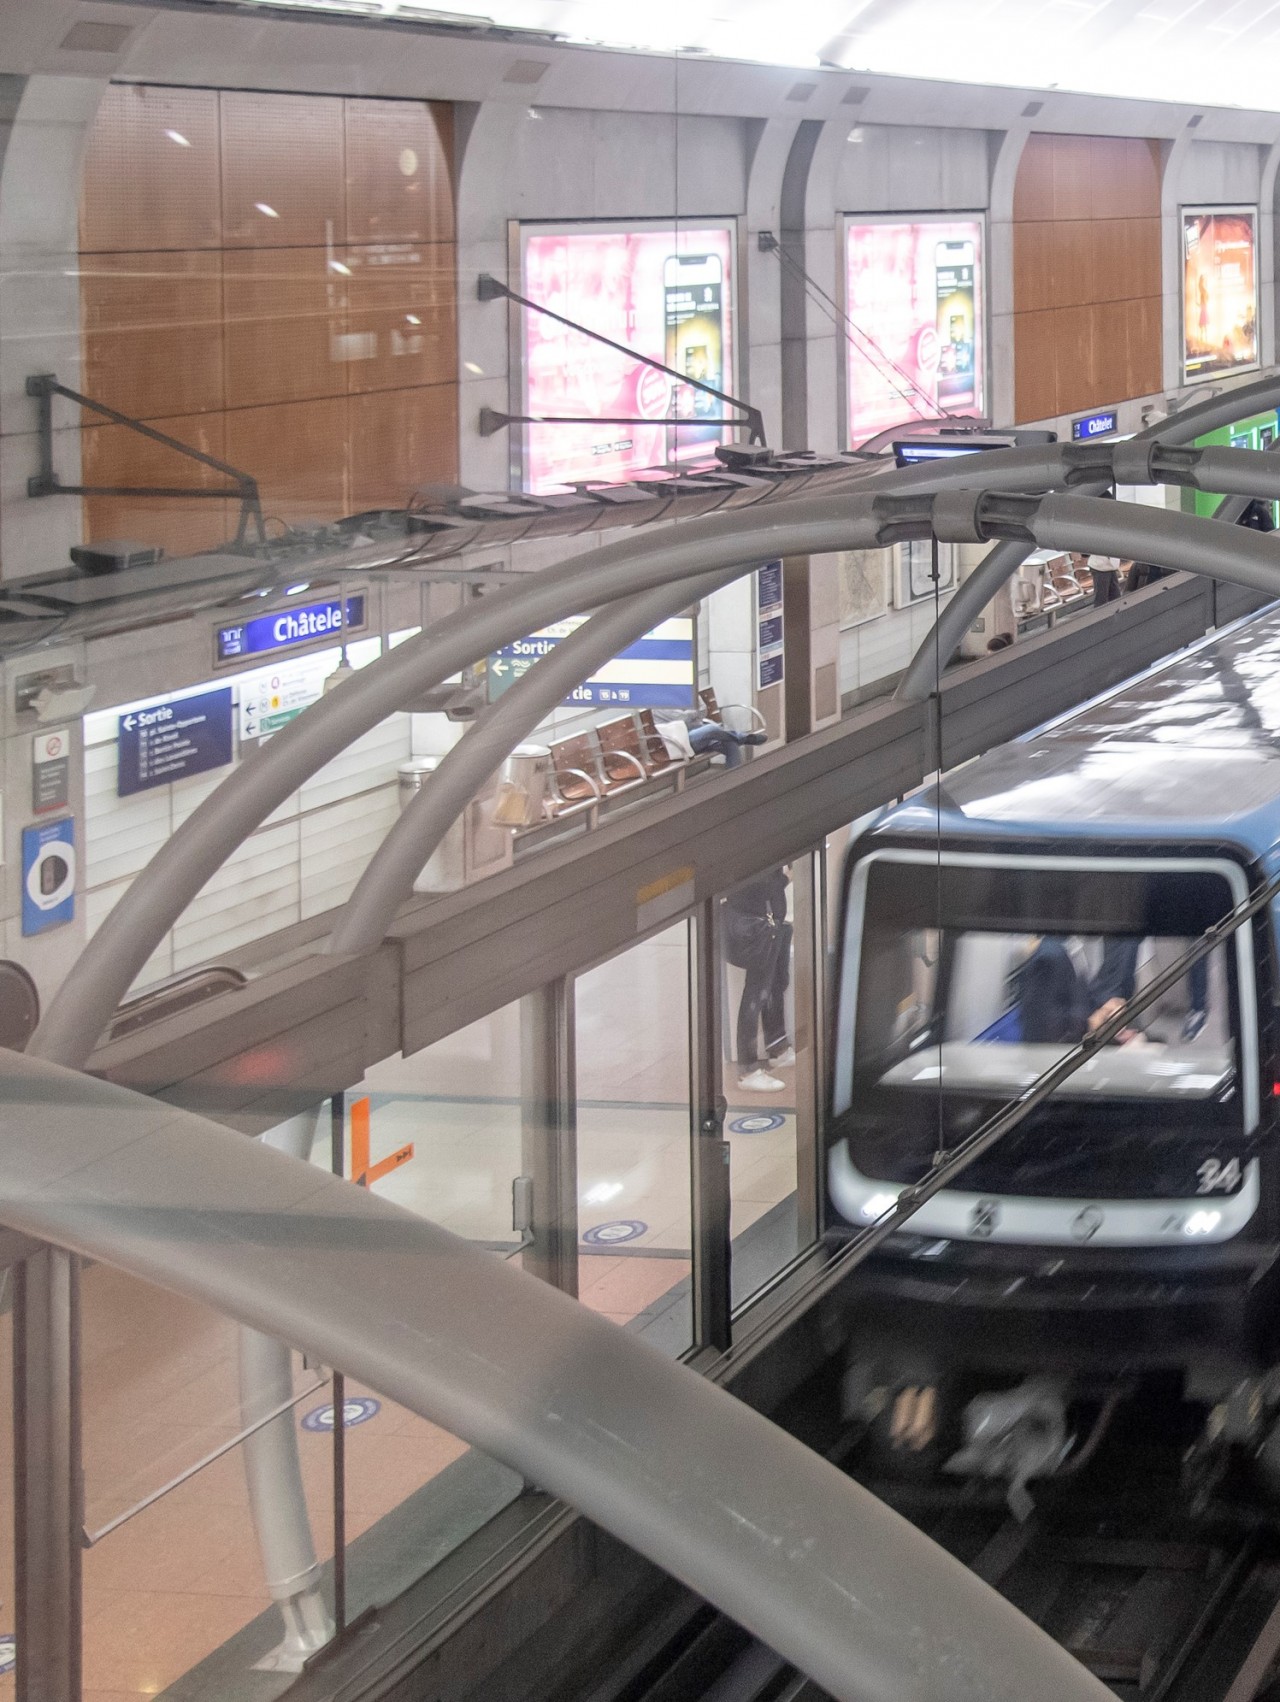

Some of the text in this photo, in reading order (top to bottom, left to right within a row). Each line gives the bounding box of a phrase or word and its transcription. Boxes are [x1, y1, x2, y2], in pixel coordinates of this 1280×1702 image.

[273, 607, 350, 642] Châtele
[138, 706, 173, 727] Sortie
[1195, 1157, 1242, 1194] 34
